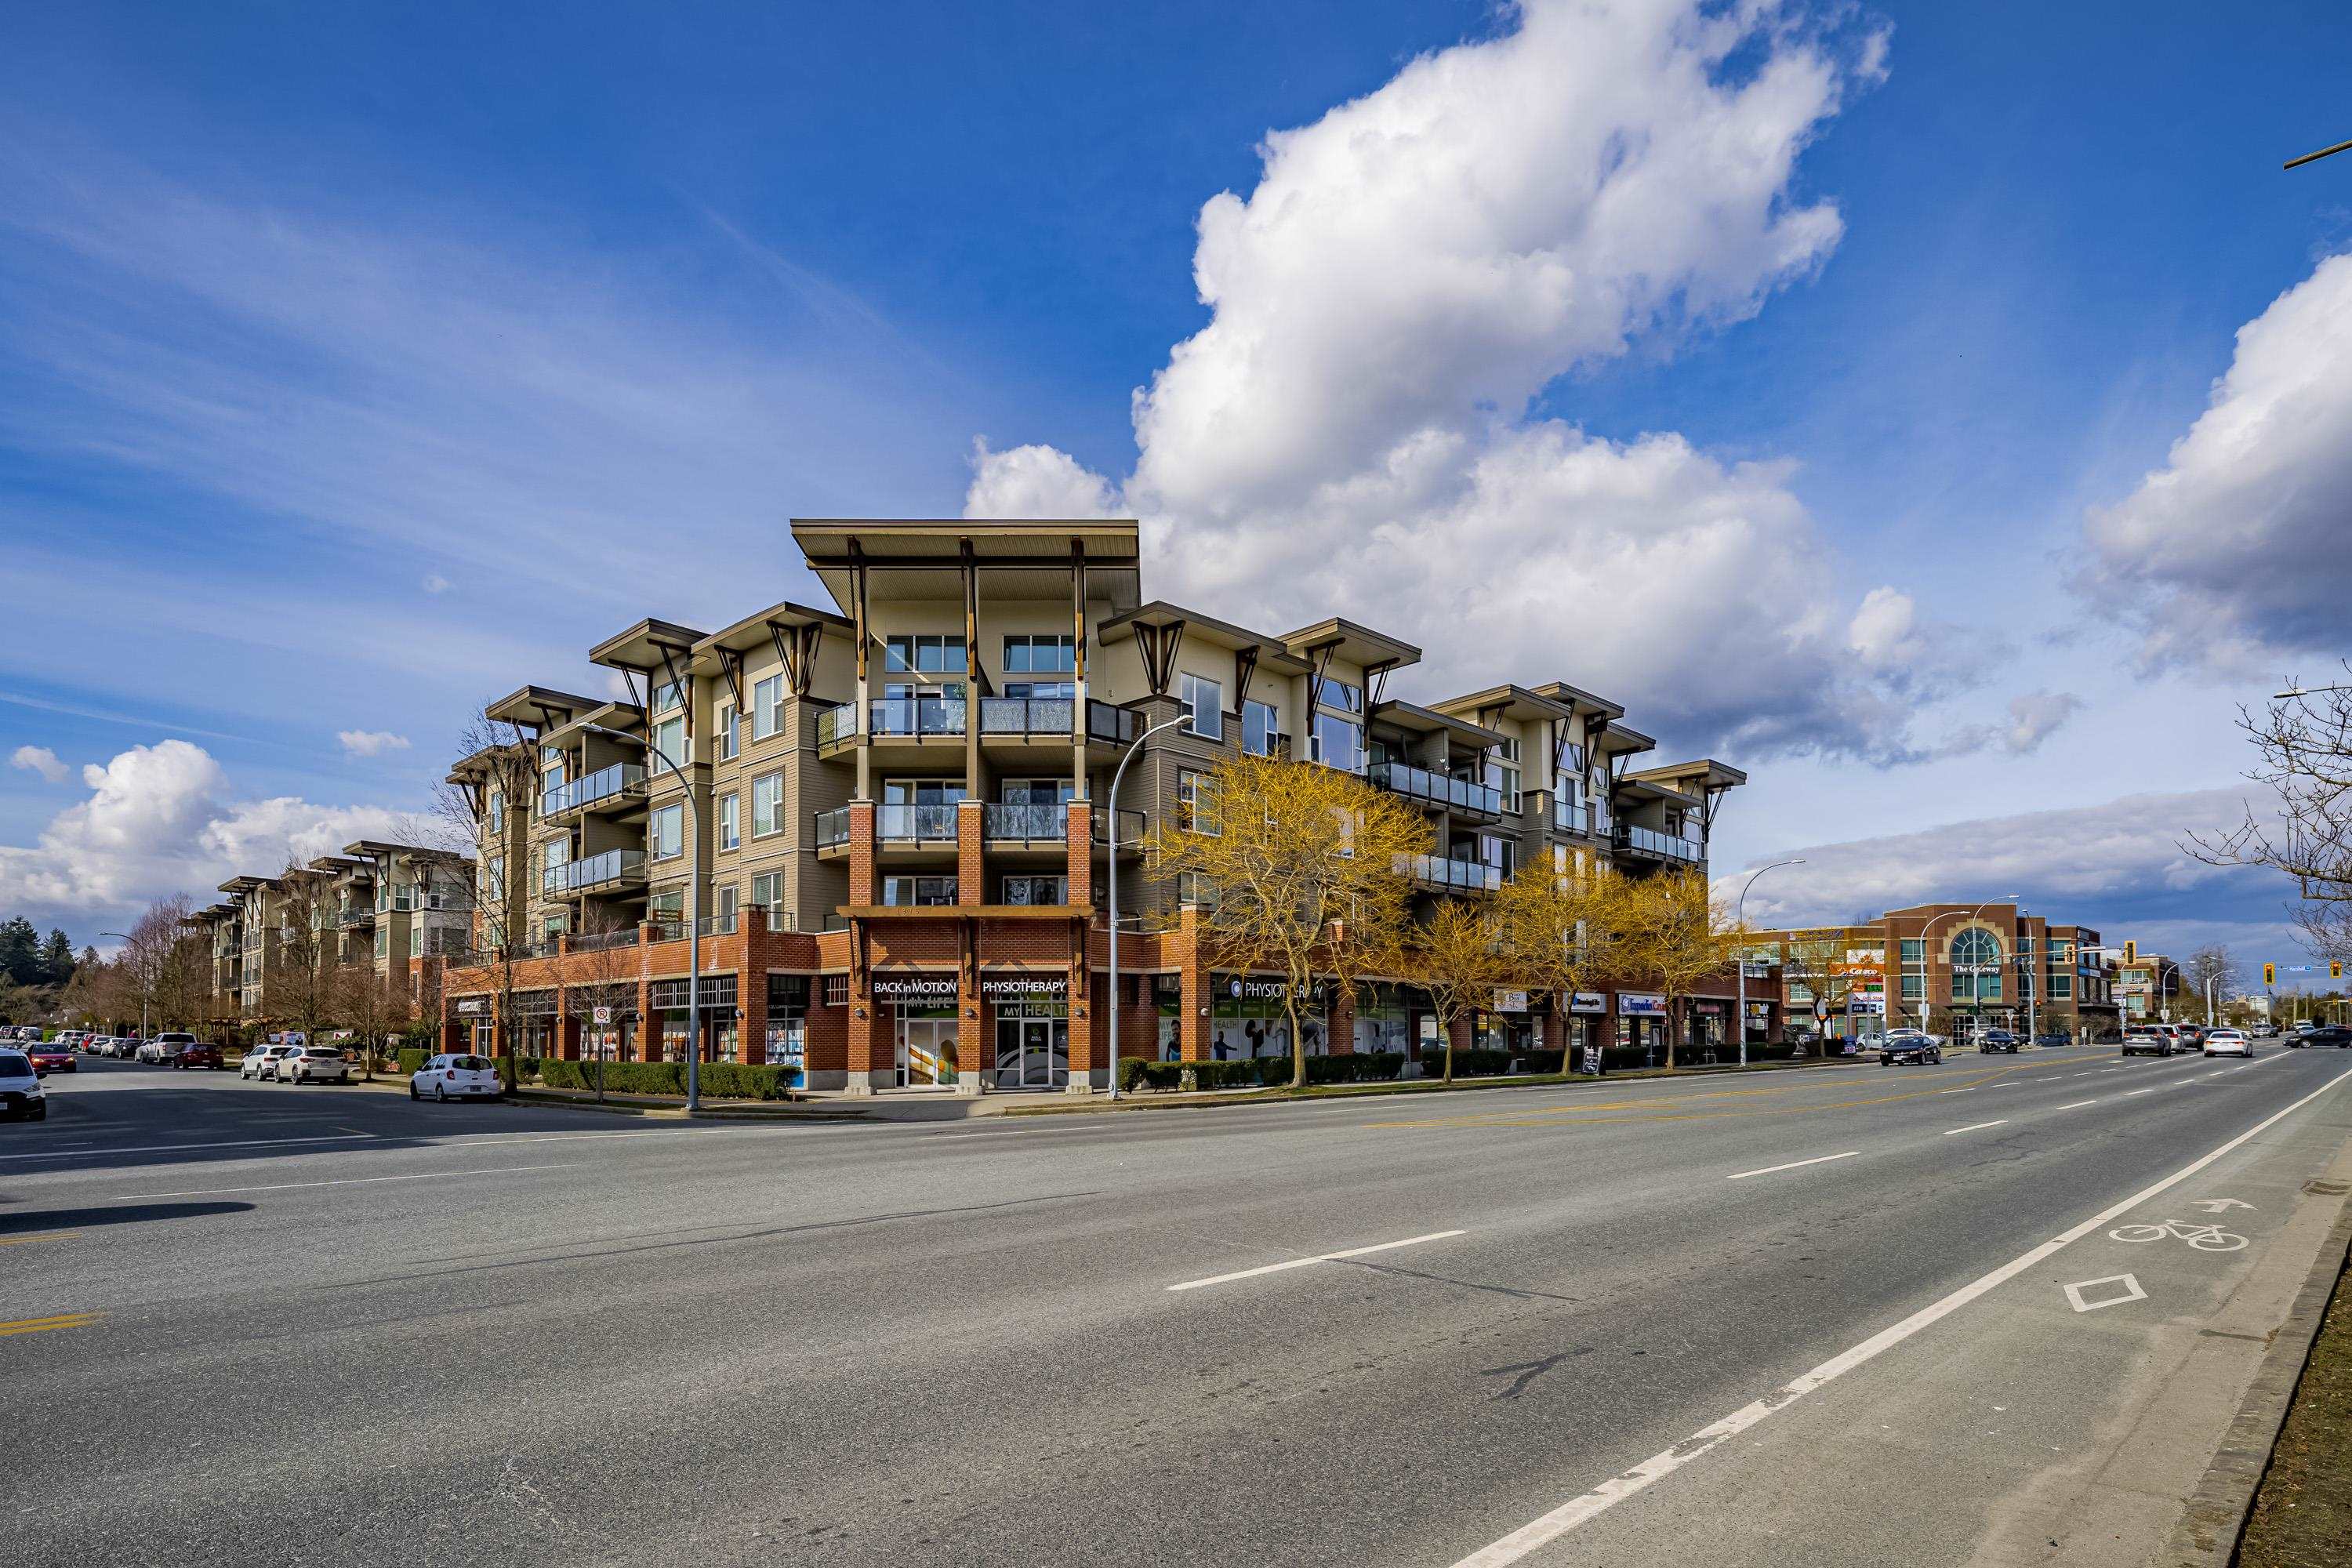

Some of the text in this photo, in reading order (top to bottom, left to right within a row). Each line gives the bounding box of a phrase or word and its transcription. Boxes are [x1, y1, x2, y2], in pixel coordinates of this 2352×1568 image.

[874, 982, 956, 993] BACK in MOTION
[983, 982, 1066, 993] PHYSIOTHERAPY
[1246, 982, 1323, 999] PHYSIOTRY
[1004, 1007, 1019, 1016] MY
[1214, 1021, 1237, 1029] HEALTH
